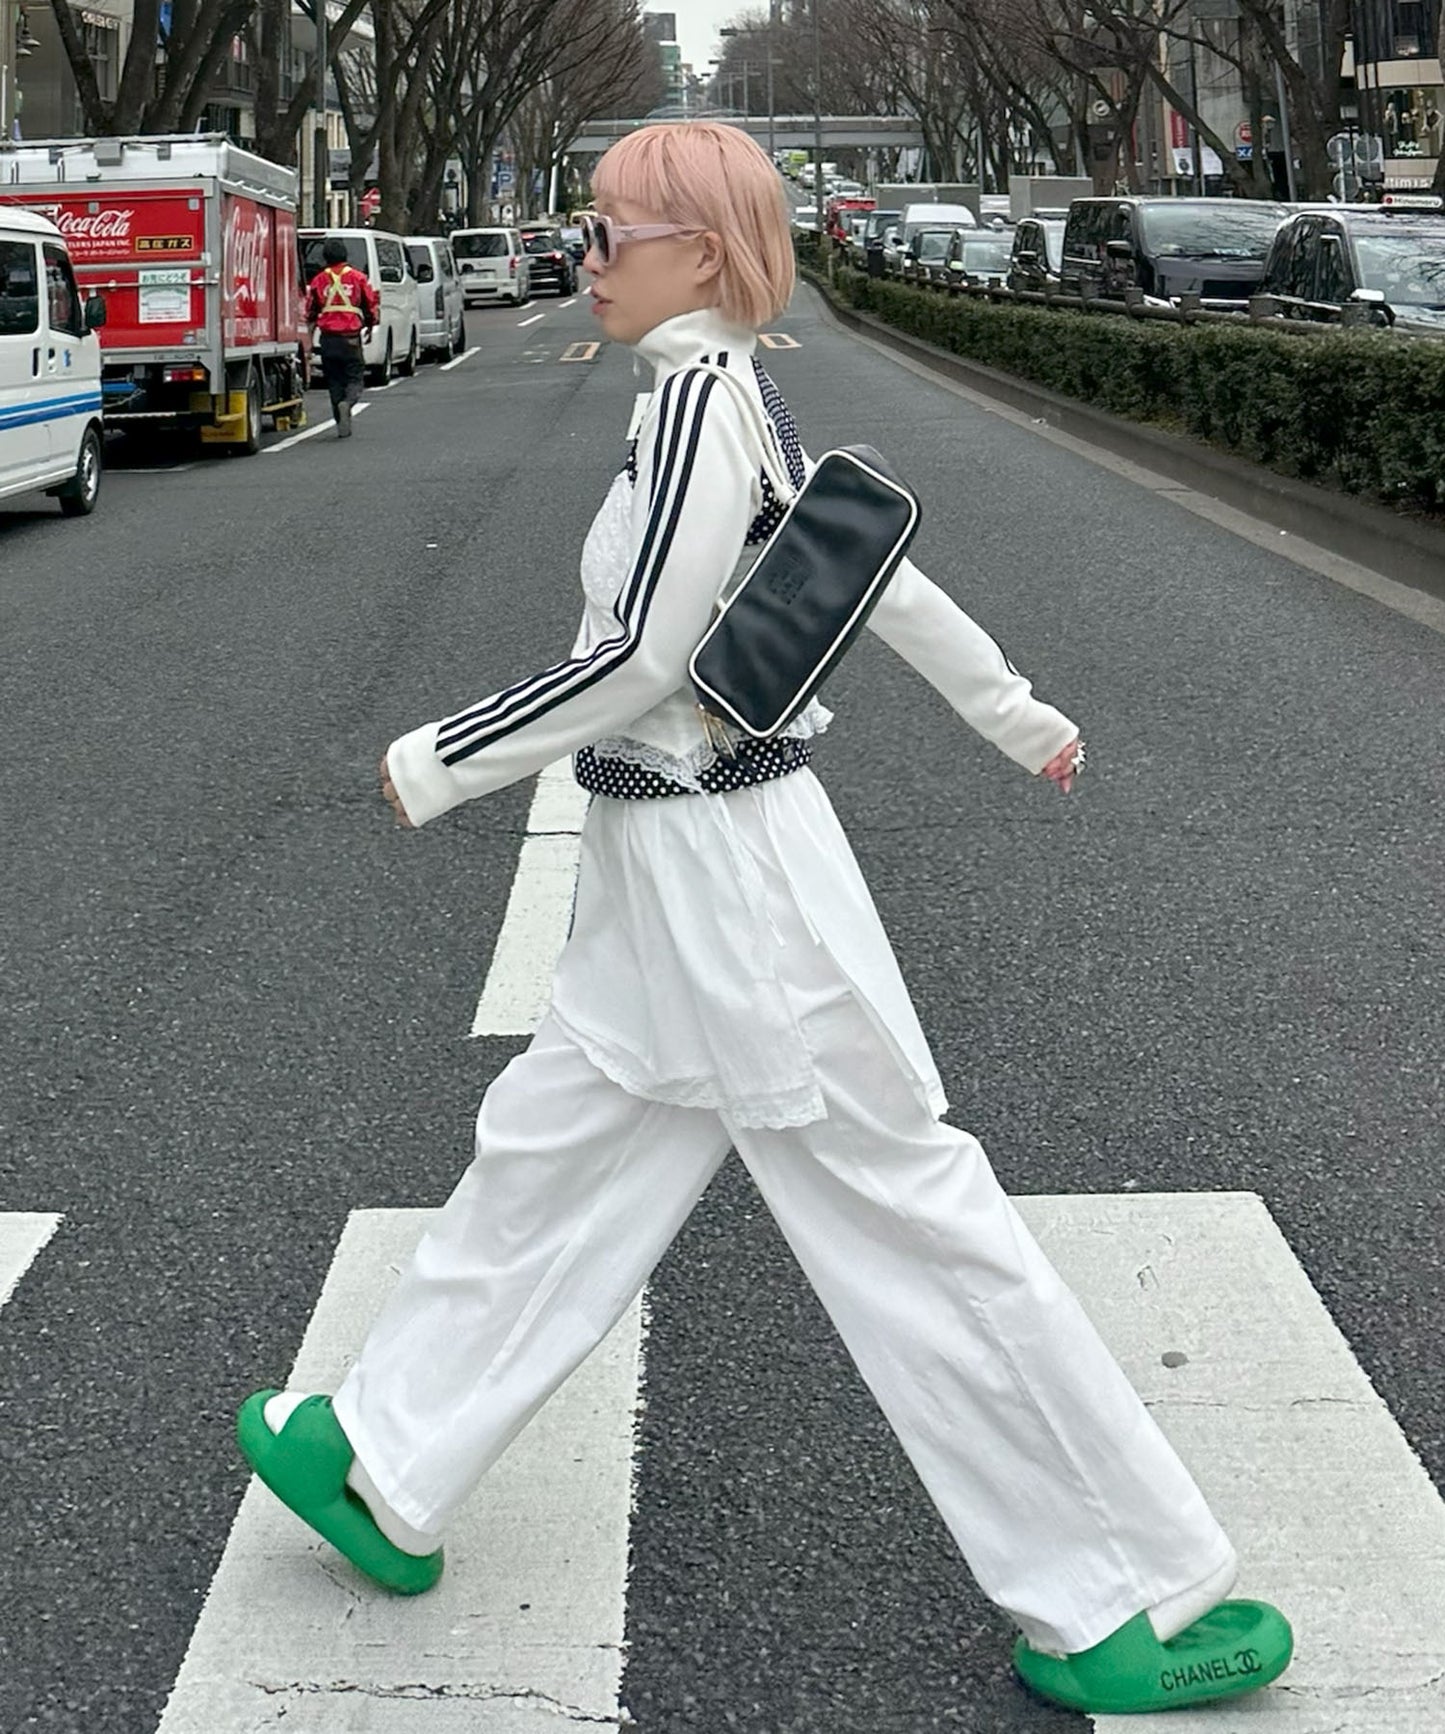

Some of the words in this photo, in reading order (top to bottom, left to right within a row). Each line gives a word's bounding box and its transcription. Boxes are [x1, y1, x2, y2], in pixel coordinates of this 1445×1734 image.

[57, 210, 134, 238] Coca-Cola
[138, 238, 191, 249] 高圧ガス
[1161, 1658, 1237, 1691] CHANEL
